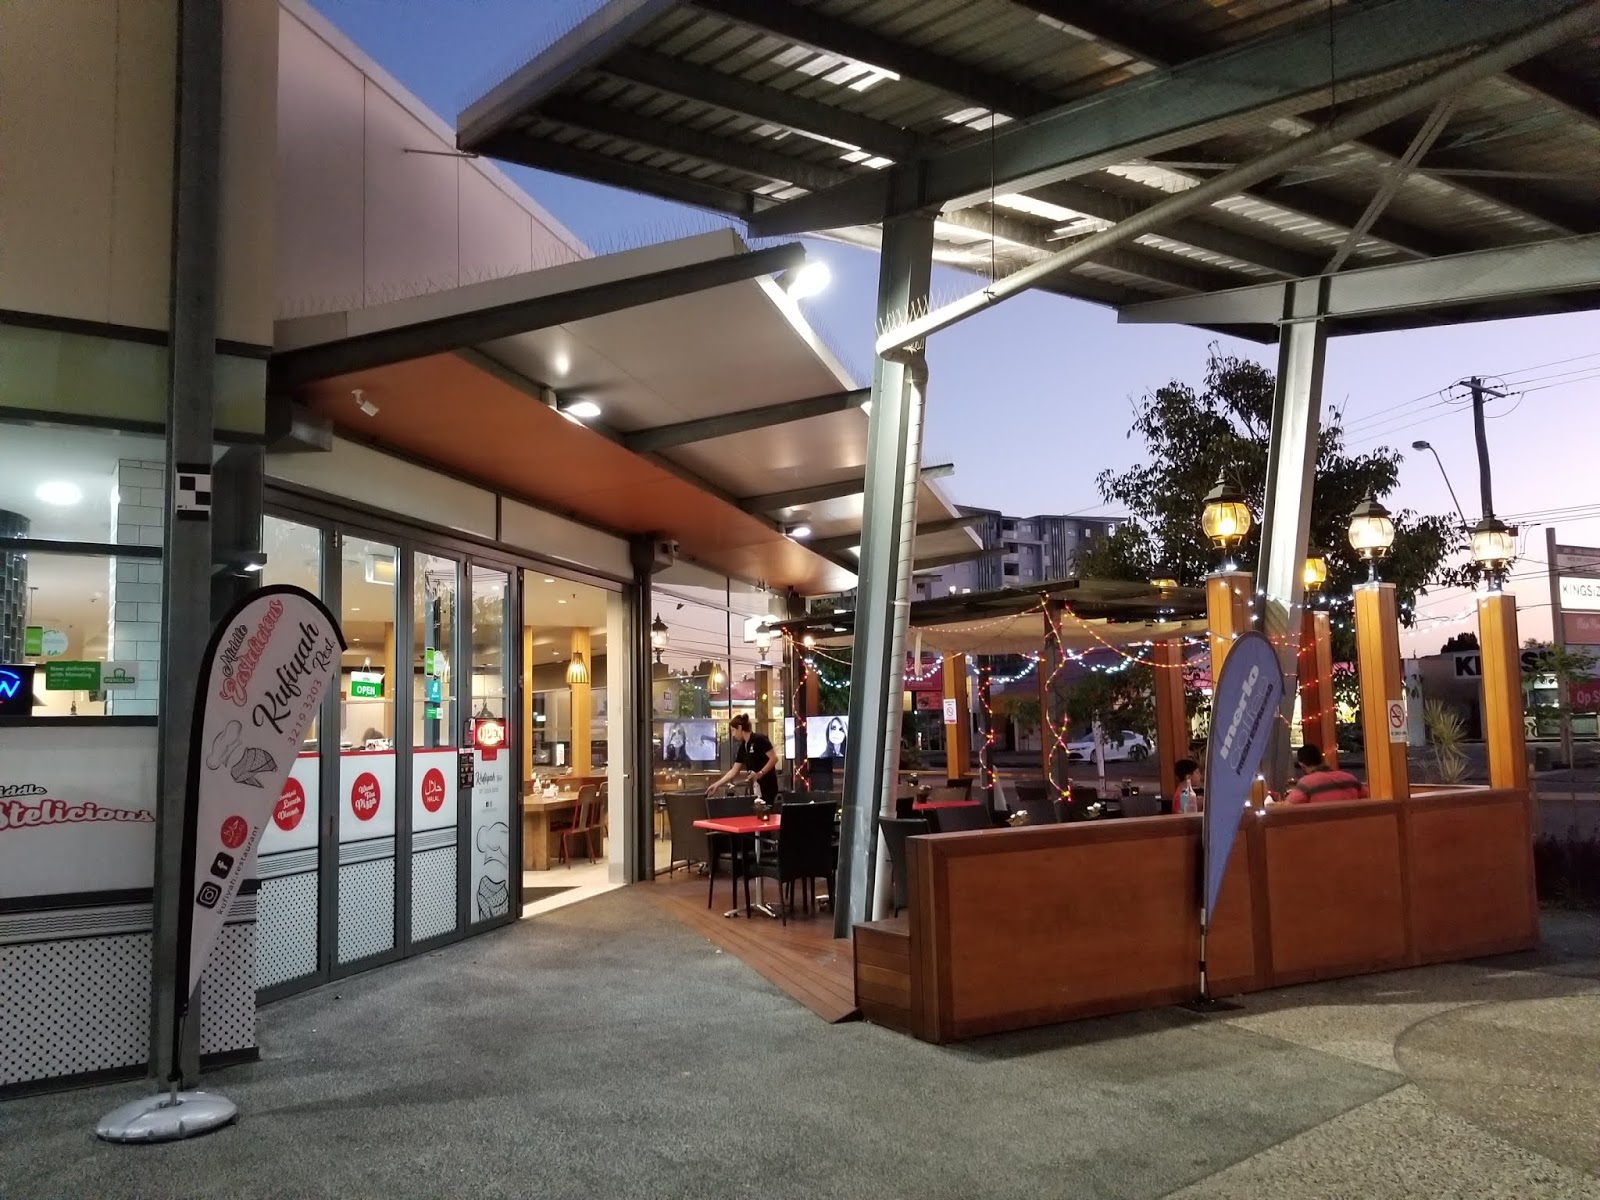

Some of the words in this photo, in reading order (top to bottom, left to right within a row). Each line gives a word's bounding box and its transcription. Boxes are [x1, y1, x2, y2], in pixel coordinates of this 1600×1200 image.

[220, 624, 249, 678] Middle
[252, 621, 320, 734] Kufiyah
[356, 685, 376, 696] OPEN
[1577, 690, 1591, 706] Op
[287, 713, 306, 747] 3219
[303, 679, 323, 711] 3203
[1220, 665, 1259, 760] merlo
[478, 725, 505, 742] OPEN
[424, 779, 443, 796] حلال
[426, 795, 440, 803] HALAL
